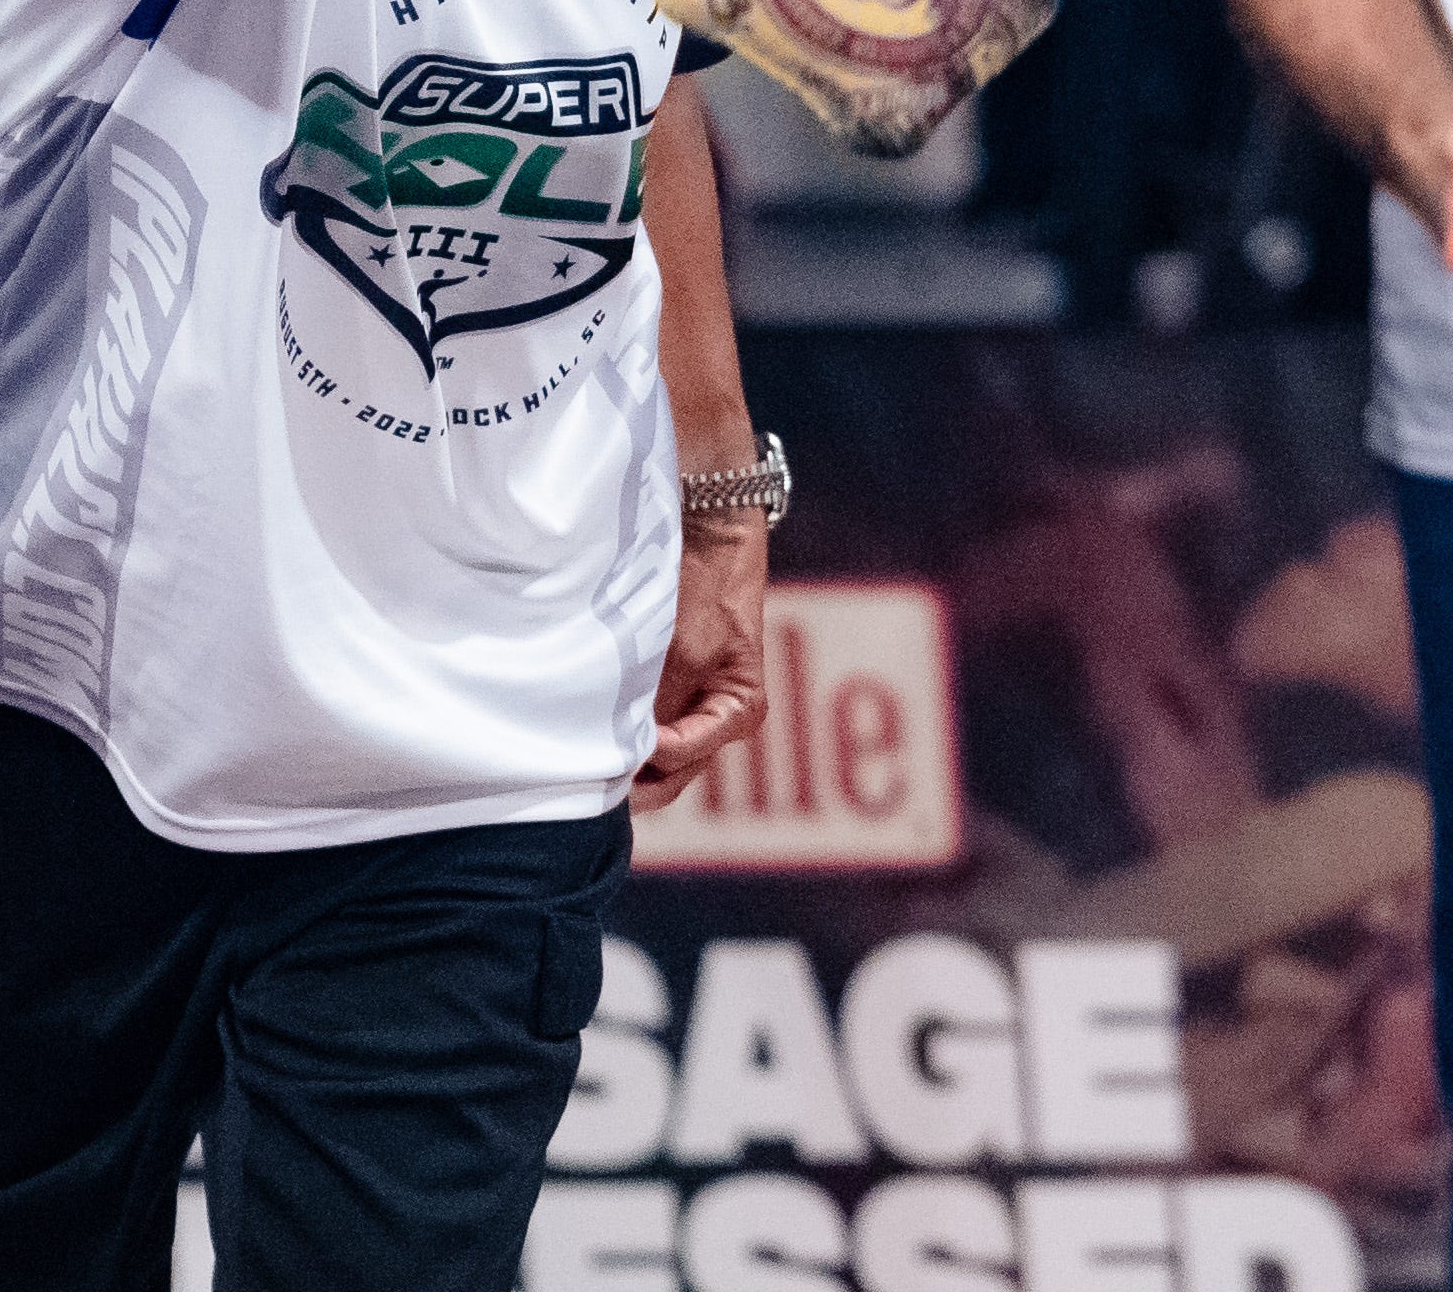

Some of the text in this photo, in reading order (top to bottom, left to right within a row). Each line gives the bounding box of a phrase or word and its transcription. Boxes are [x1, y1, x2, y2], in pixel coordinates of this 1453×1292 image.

[400, 75, 628, 129] SUPER
[406, 224, 500, 266] III
[297, 359, 338, 398] 5TH
[355, 404, 432, 444] 2022
[446, 402, 512, 427] OCK
[581, 309, 606, 344] SC
[547, 934, 1189, 1167] SAGE
